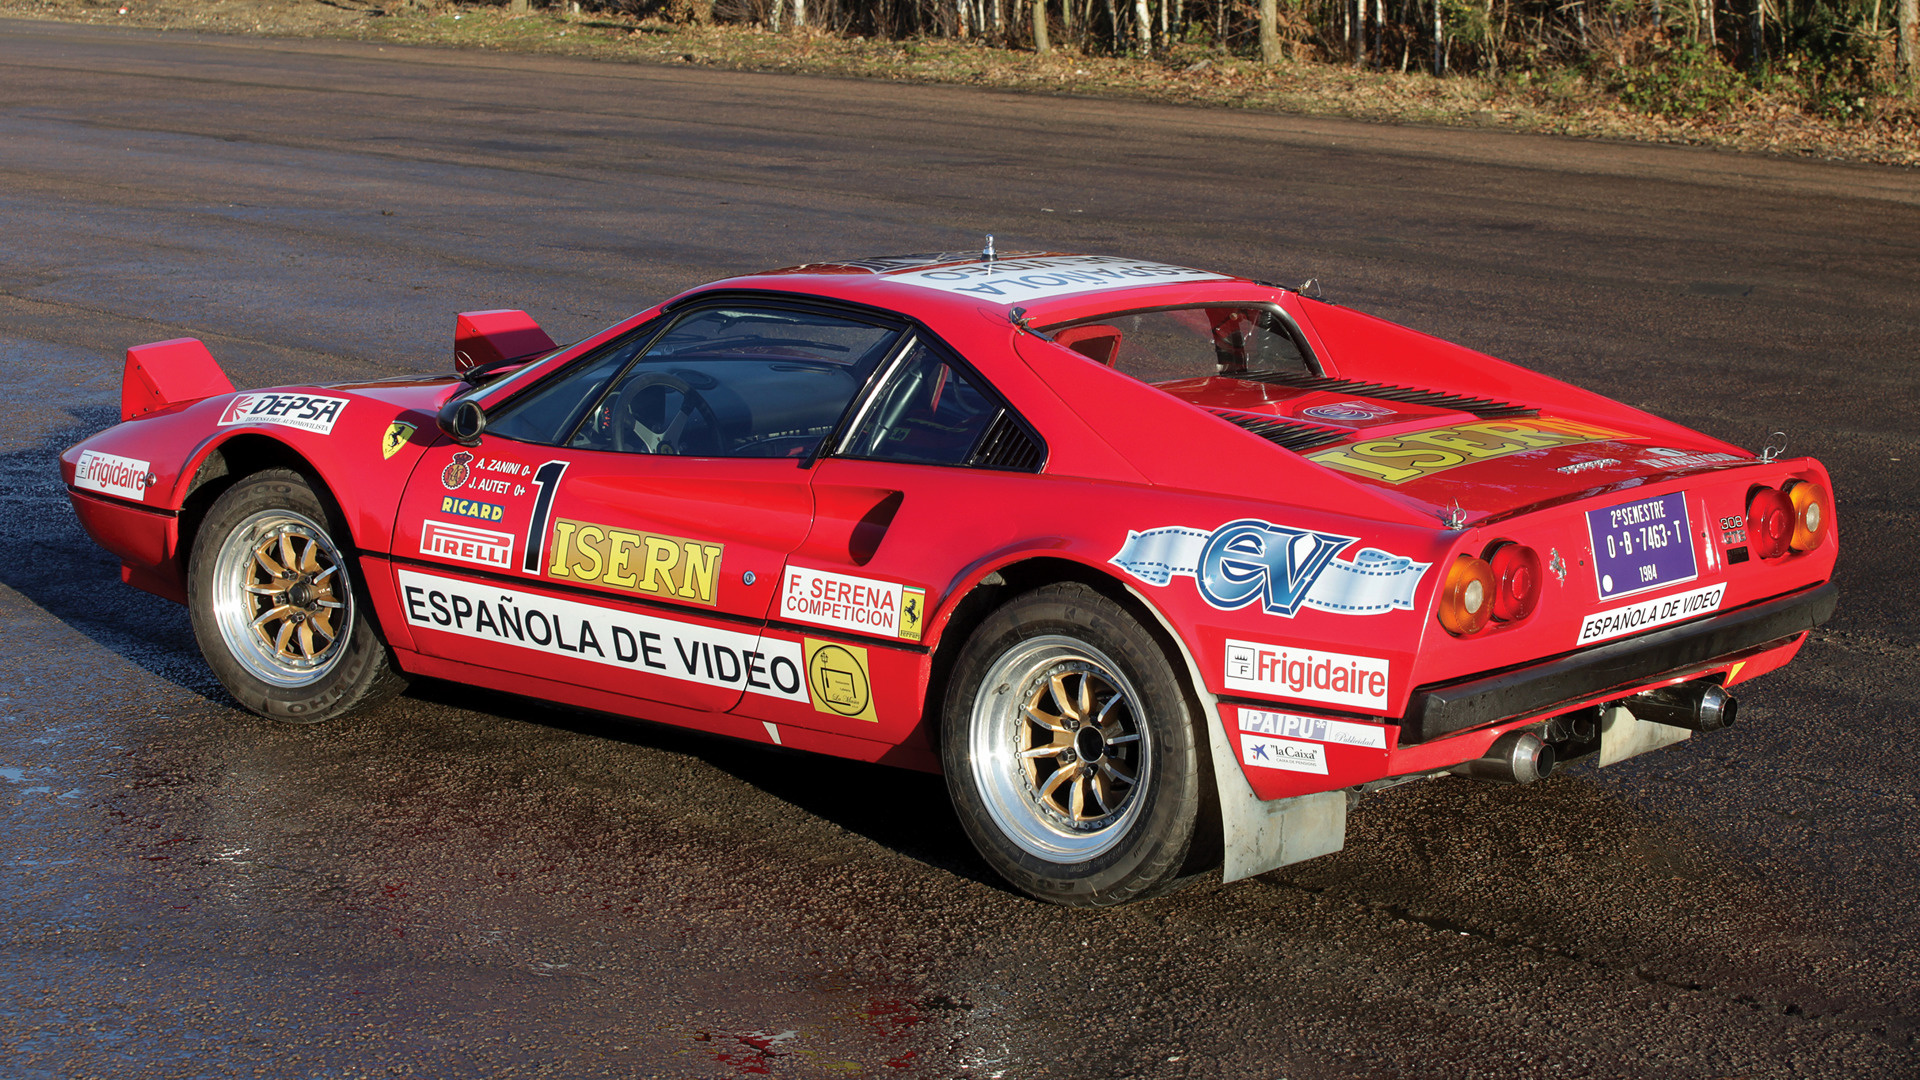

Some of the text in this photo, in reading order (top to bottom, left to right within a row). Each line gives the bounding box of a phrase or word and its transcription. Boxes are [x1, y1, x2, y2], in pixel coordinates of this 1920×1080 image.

[250, 395, 342, 423] DEPSA
[280, 418, 328, 432] AUTOMOVILISTA
[1308, 416, 1636, 481] ISERN
[87, 456, 145, 491] Frigidaire
[475, 458, 486, 470] A.
[487, 460, 521, 475] ZANINI
[468, 477, 477, 489] J.
[478, 478, 511, 494] AUTET
[441, 496, 503, 520] RICARD
[522, 460, 570, 575] 1
[1720, 515, 1743, 530] 308
[423, 523, 511, 565] PIRELLI
[550, 521, 722, 602] ISERN
[1639, 563, 1658, 583] 1984
[789, 574, 895, 612] F. SERENA
[786, 596, 894, 629] COMPETICION
[1582, 589, 1721, 640] ESPAÑOLA DE VIDEO
[405, 586, 801, 695] ESPAÑOLA DE VIDEO
[1257, 650, 1386, 698] Frigidaire
[1249, 711, 1376, 746] PAIPU Publicidad
